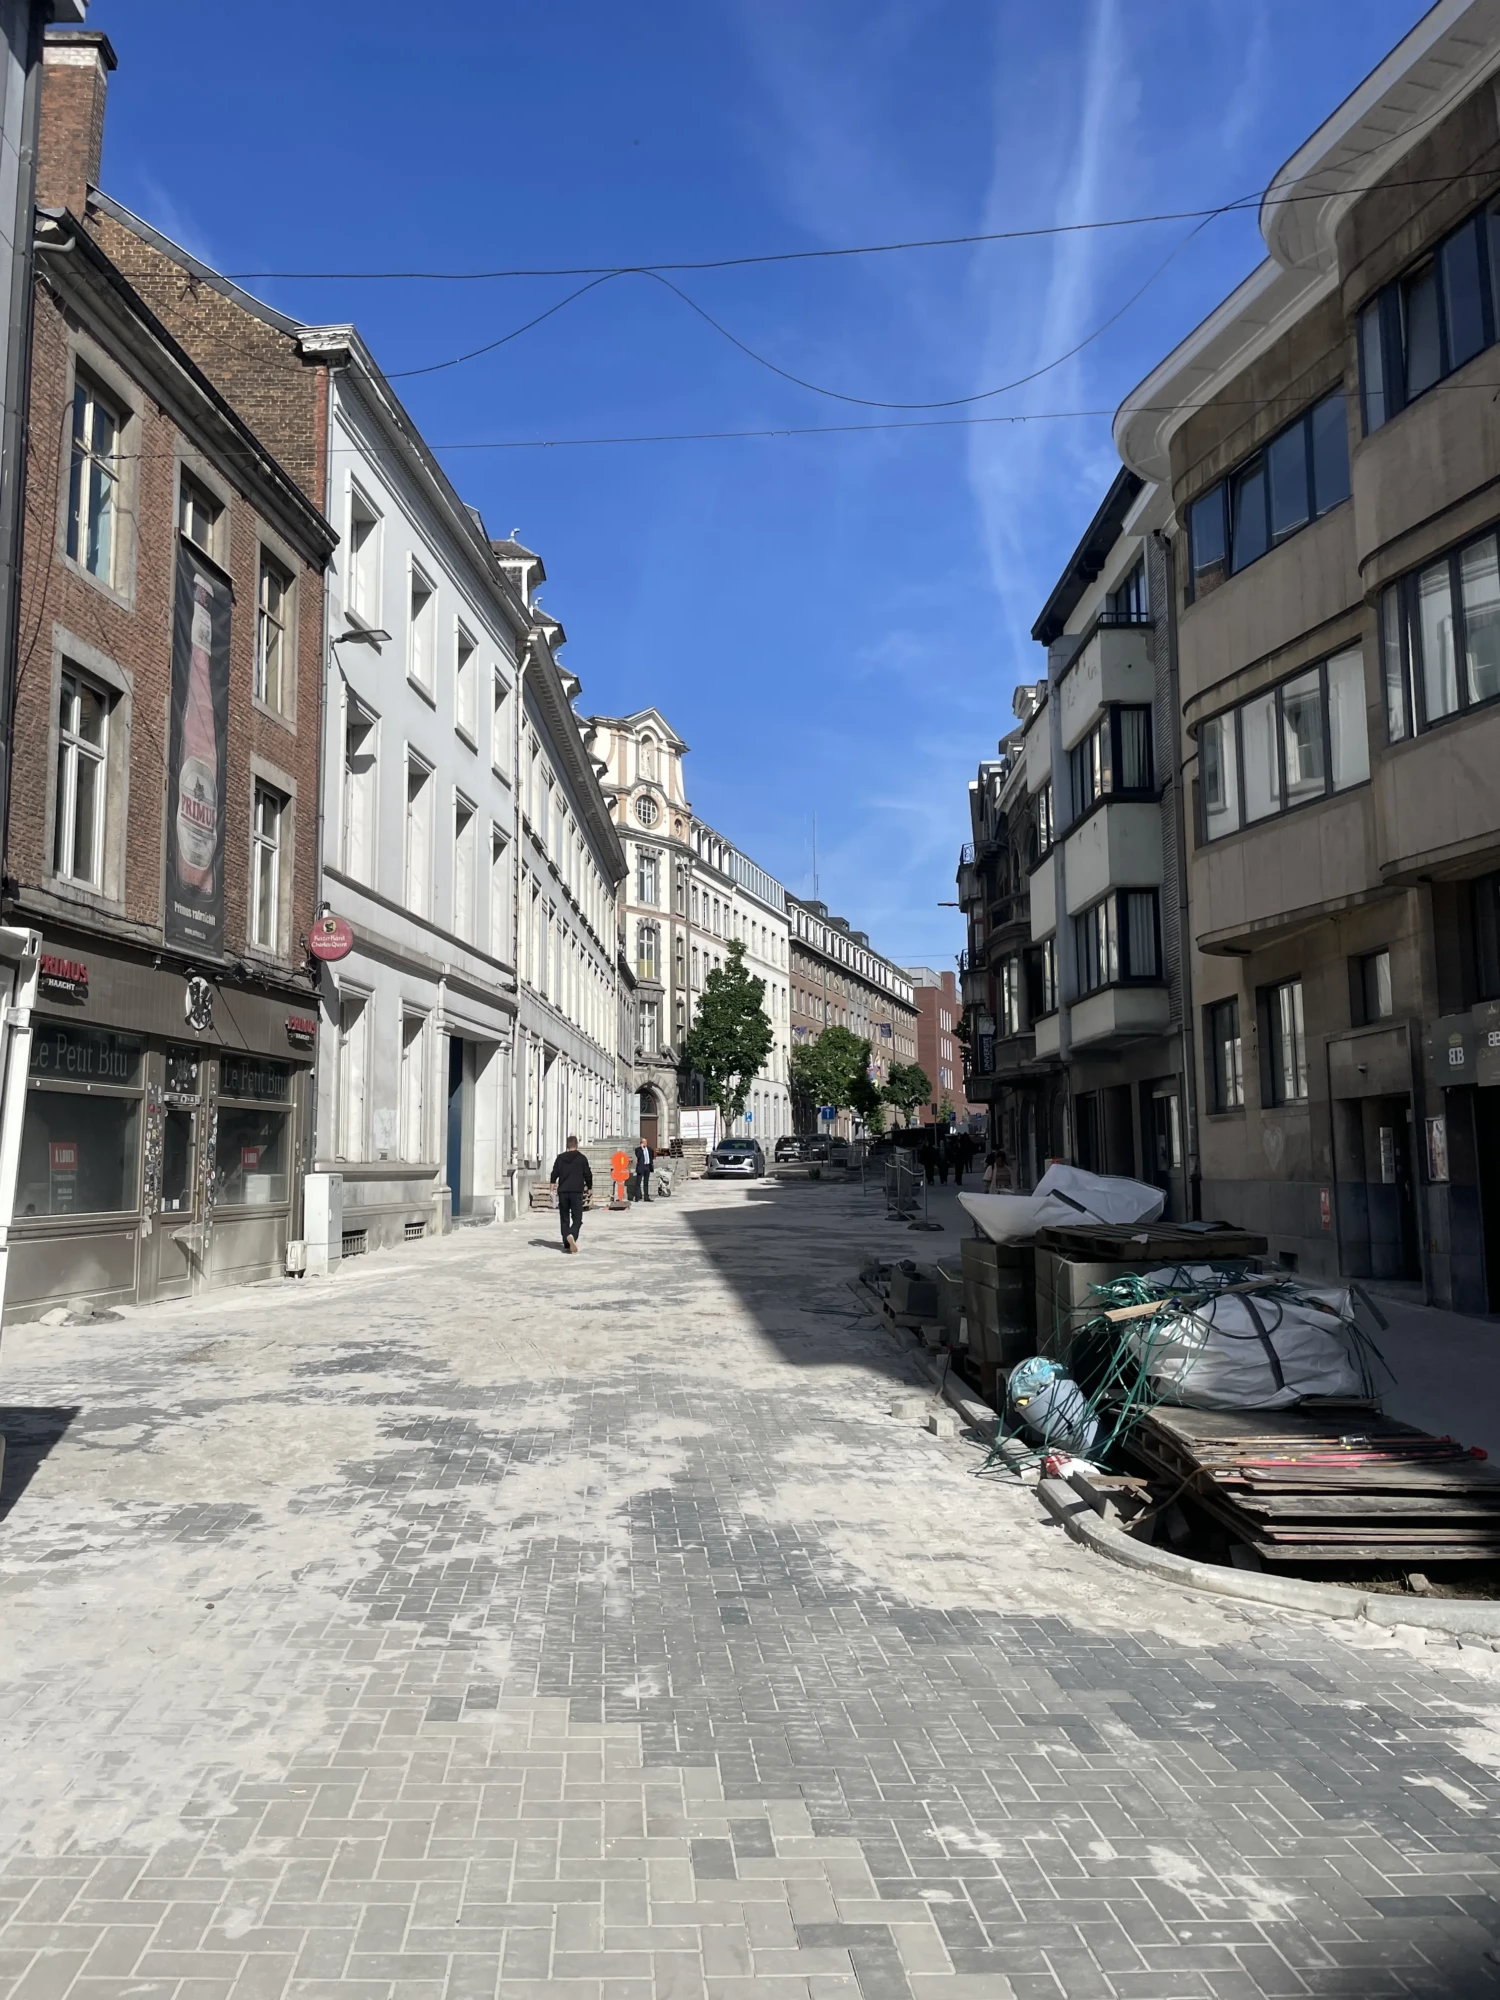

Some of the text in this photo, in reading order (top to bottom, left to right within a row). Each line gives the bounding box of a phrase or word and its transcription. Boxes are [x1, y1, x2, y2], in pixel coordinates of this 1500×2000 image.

[48, 978, 75, 991] HAACHT
[287, 1015, 317, 1034] PRIMUS
[55, 1033, 93, 1073] Petit
[98, 1041, 127, 1077] Bitu
[223, 1060, 238, 1089] Le
[240, 1062, 264, 1093] Petit
